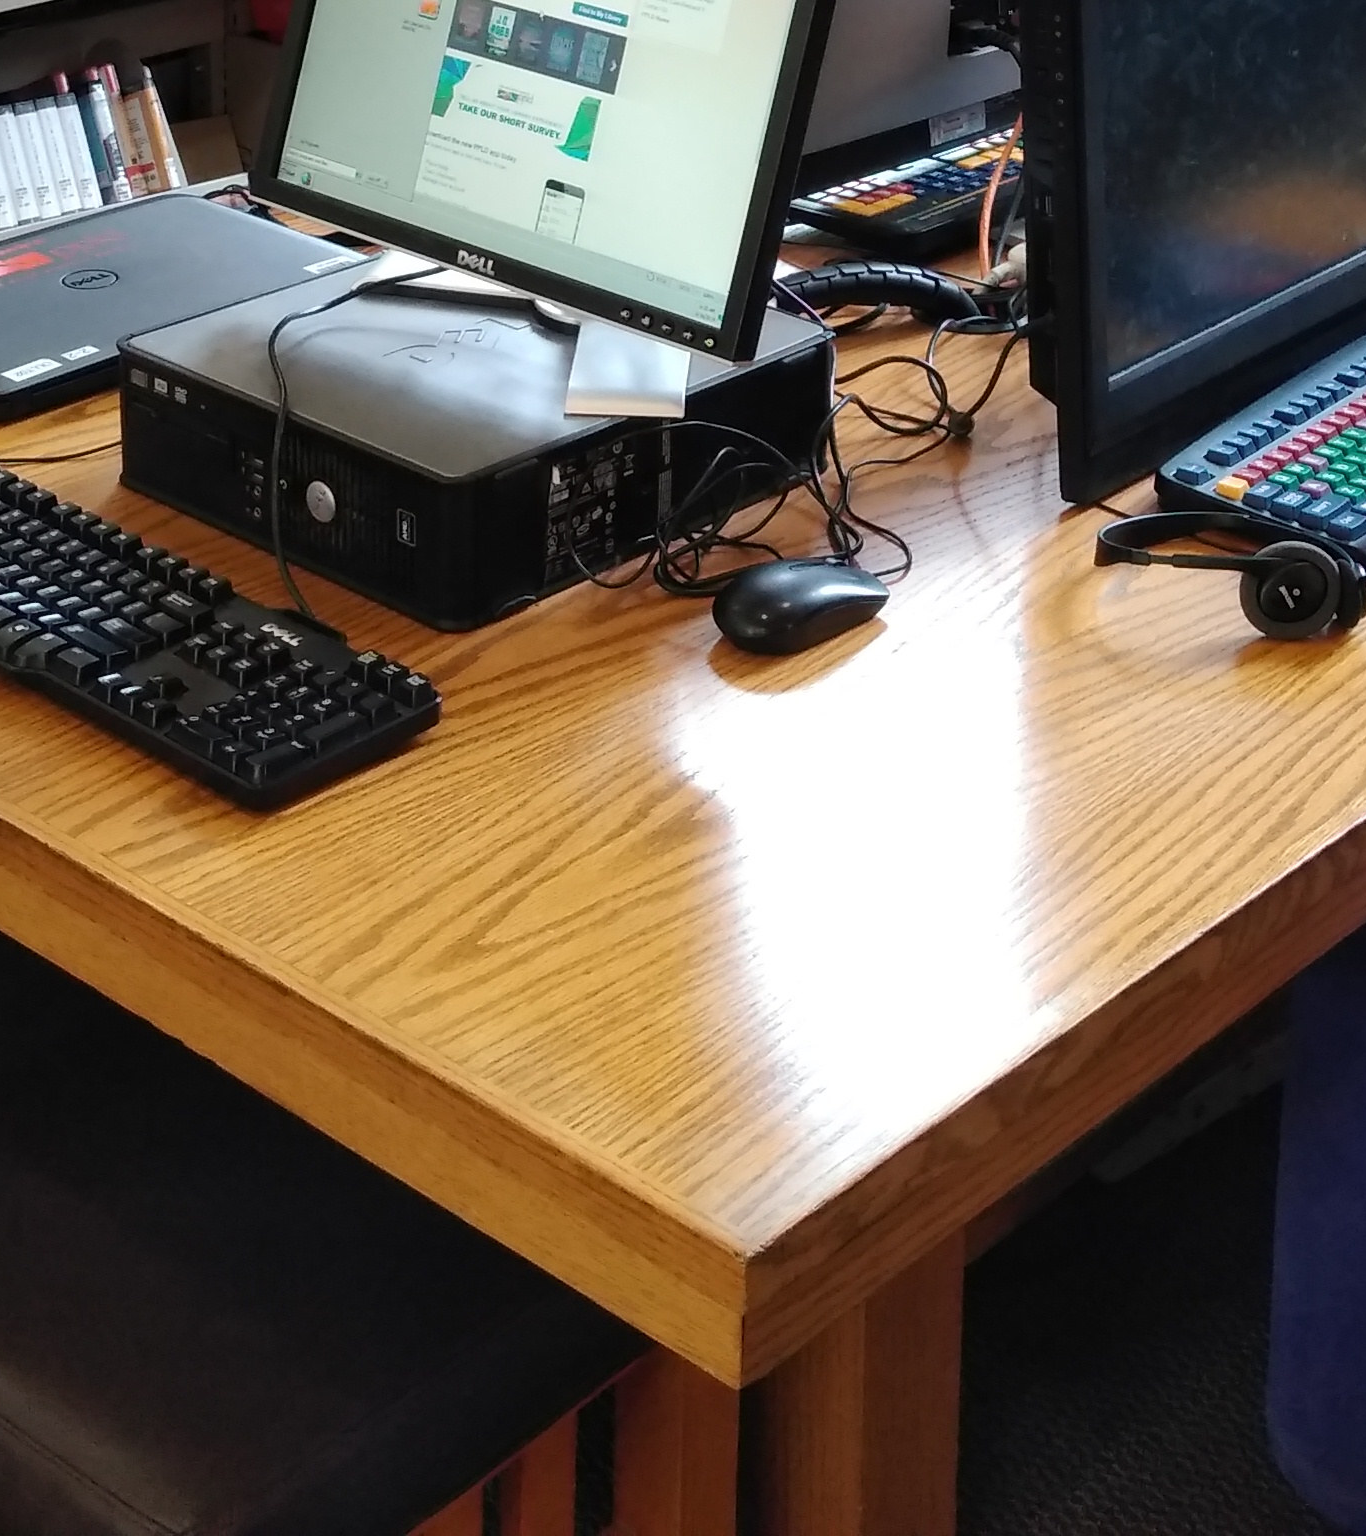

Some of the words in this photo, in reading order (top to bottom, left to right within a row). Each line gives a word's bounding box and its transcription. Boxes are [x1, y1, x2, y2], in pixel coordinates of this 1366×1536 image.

[458, 102, 479, 115] TAKE
[480, 109, 498, 120] OUR
[499, 114, 526, 130] SHORT
[456, 249, 496, 277] DELL
[69, 272, 111, 287] DELL
[259, 622, 304, 647] DELL
